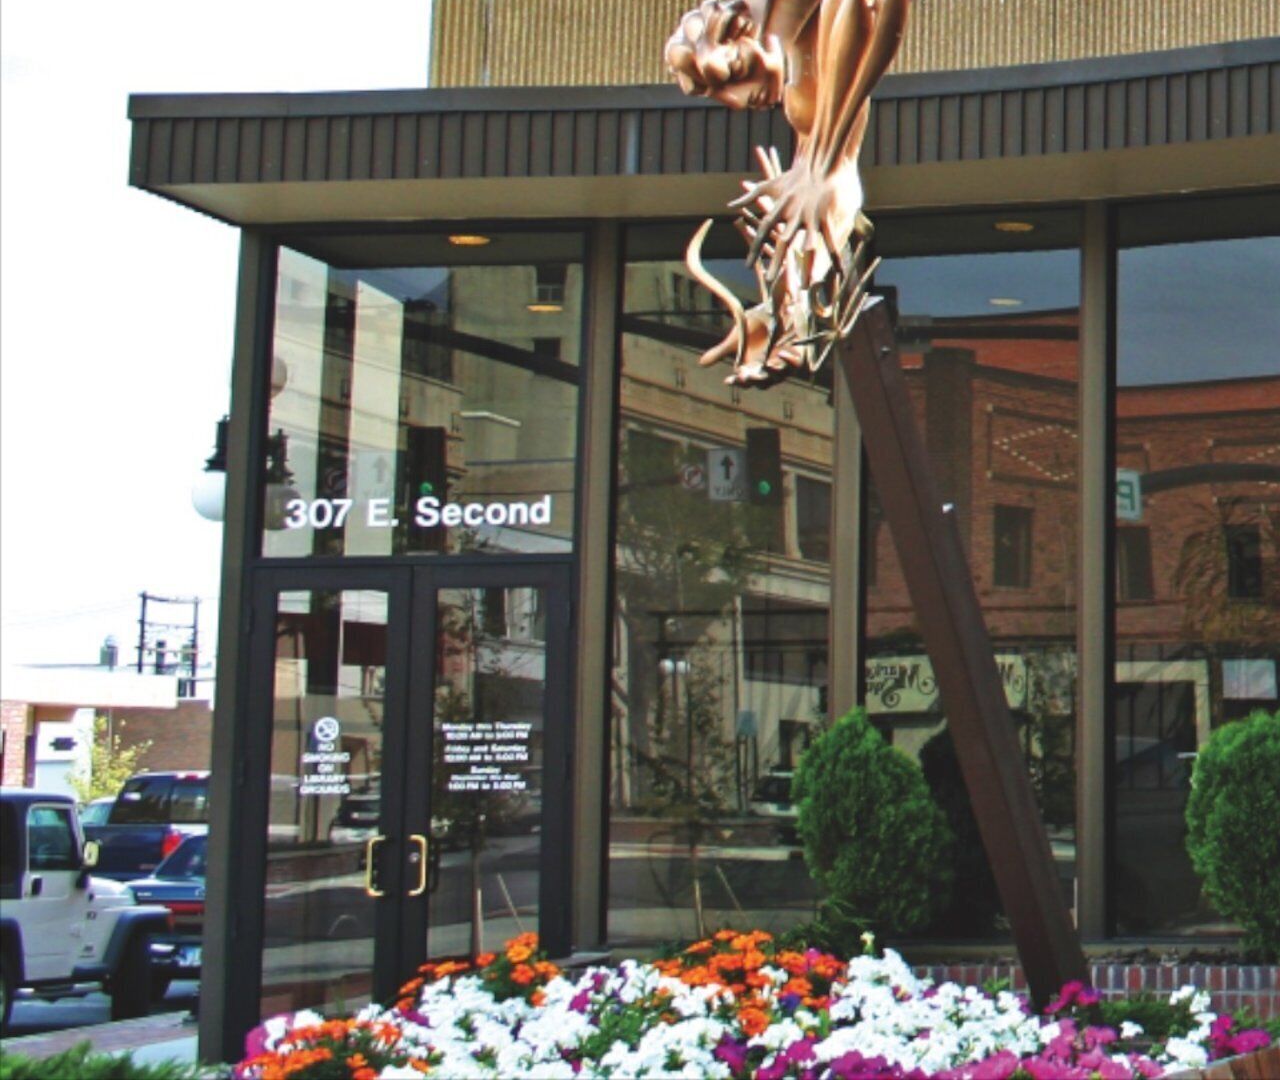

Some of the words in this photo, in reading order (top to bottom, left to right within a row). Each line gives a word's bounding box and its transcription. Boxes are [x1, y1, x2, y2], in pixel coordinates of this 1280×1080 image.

[285, 498, 353, 528] 307
[366, 498, 399, 527] E.
[415, 495, 552, 528] Second
